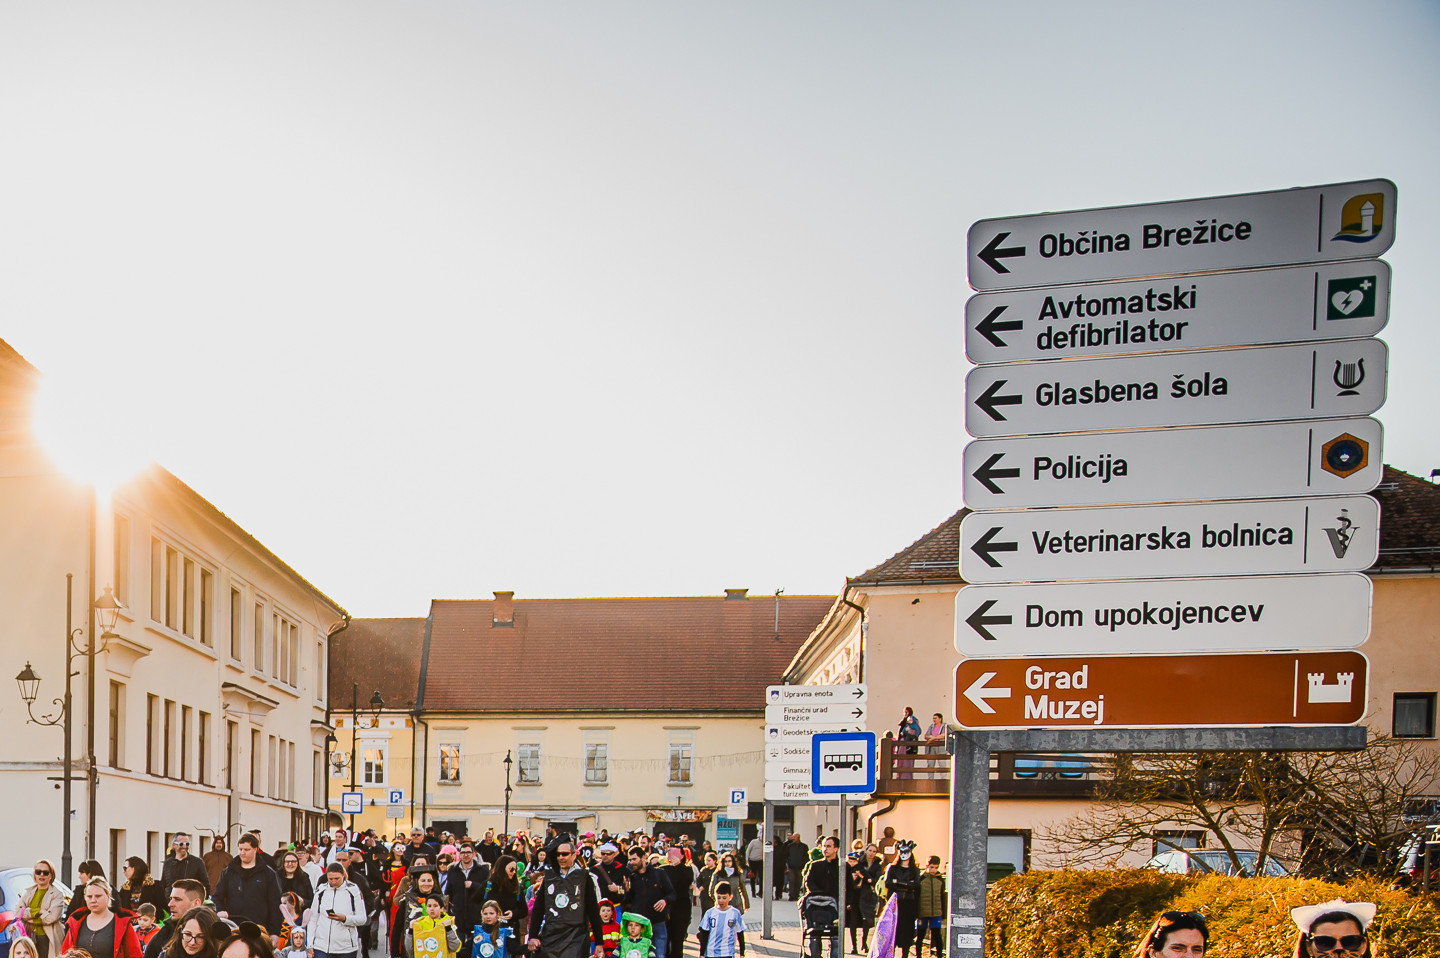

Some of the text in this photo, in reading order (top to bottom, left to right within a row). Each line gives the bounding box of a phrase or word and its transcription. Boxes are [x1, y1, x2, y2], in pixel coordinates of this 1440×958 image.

[1039, 219, 1252, 259] Občina Brežice
[1038, 285, 1197, 321] Avtomatski
[1036, 318, 1189, 350] defibrilator
[1035, 372, 1228, 407] Glasbena šola
[1033, 454, 1128, 483] Policija
[1032, 522, 1294, 555] Veterinarska bolnica
[1025, 601, 1264, 632] Dom upokojencev
[1025, 664, 1089, 690] Grad
[1024, 694, 1105, 724] Muzej
